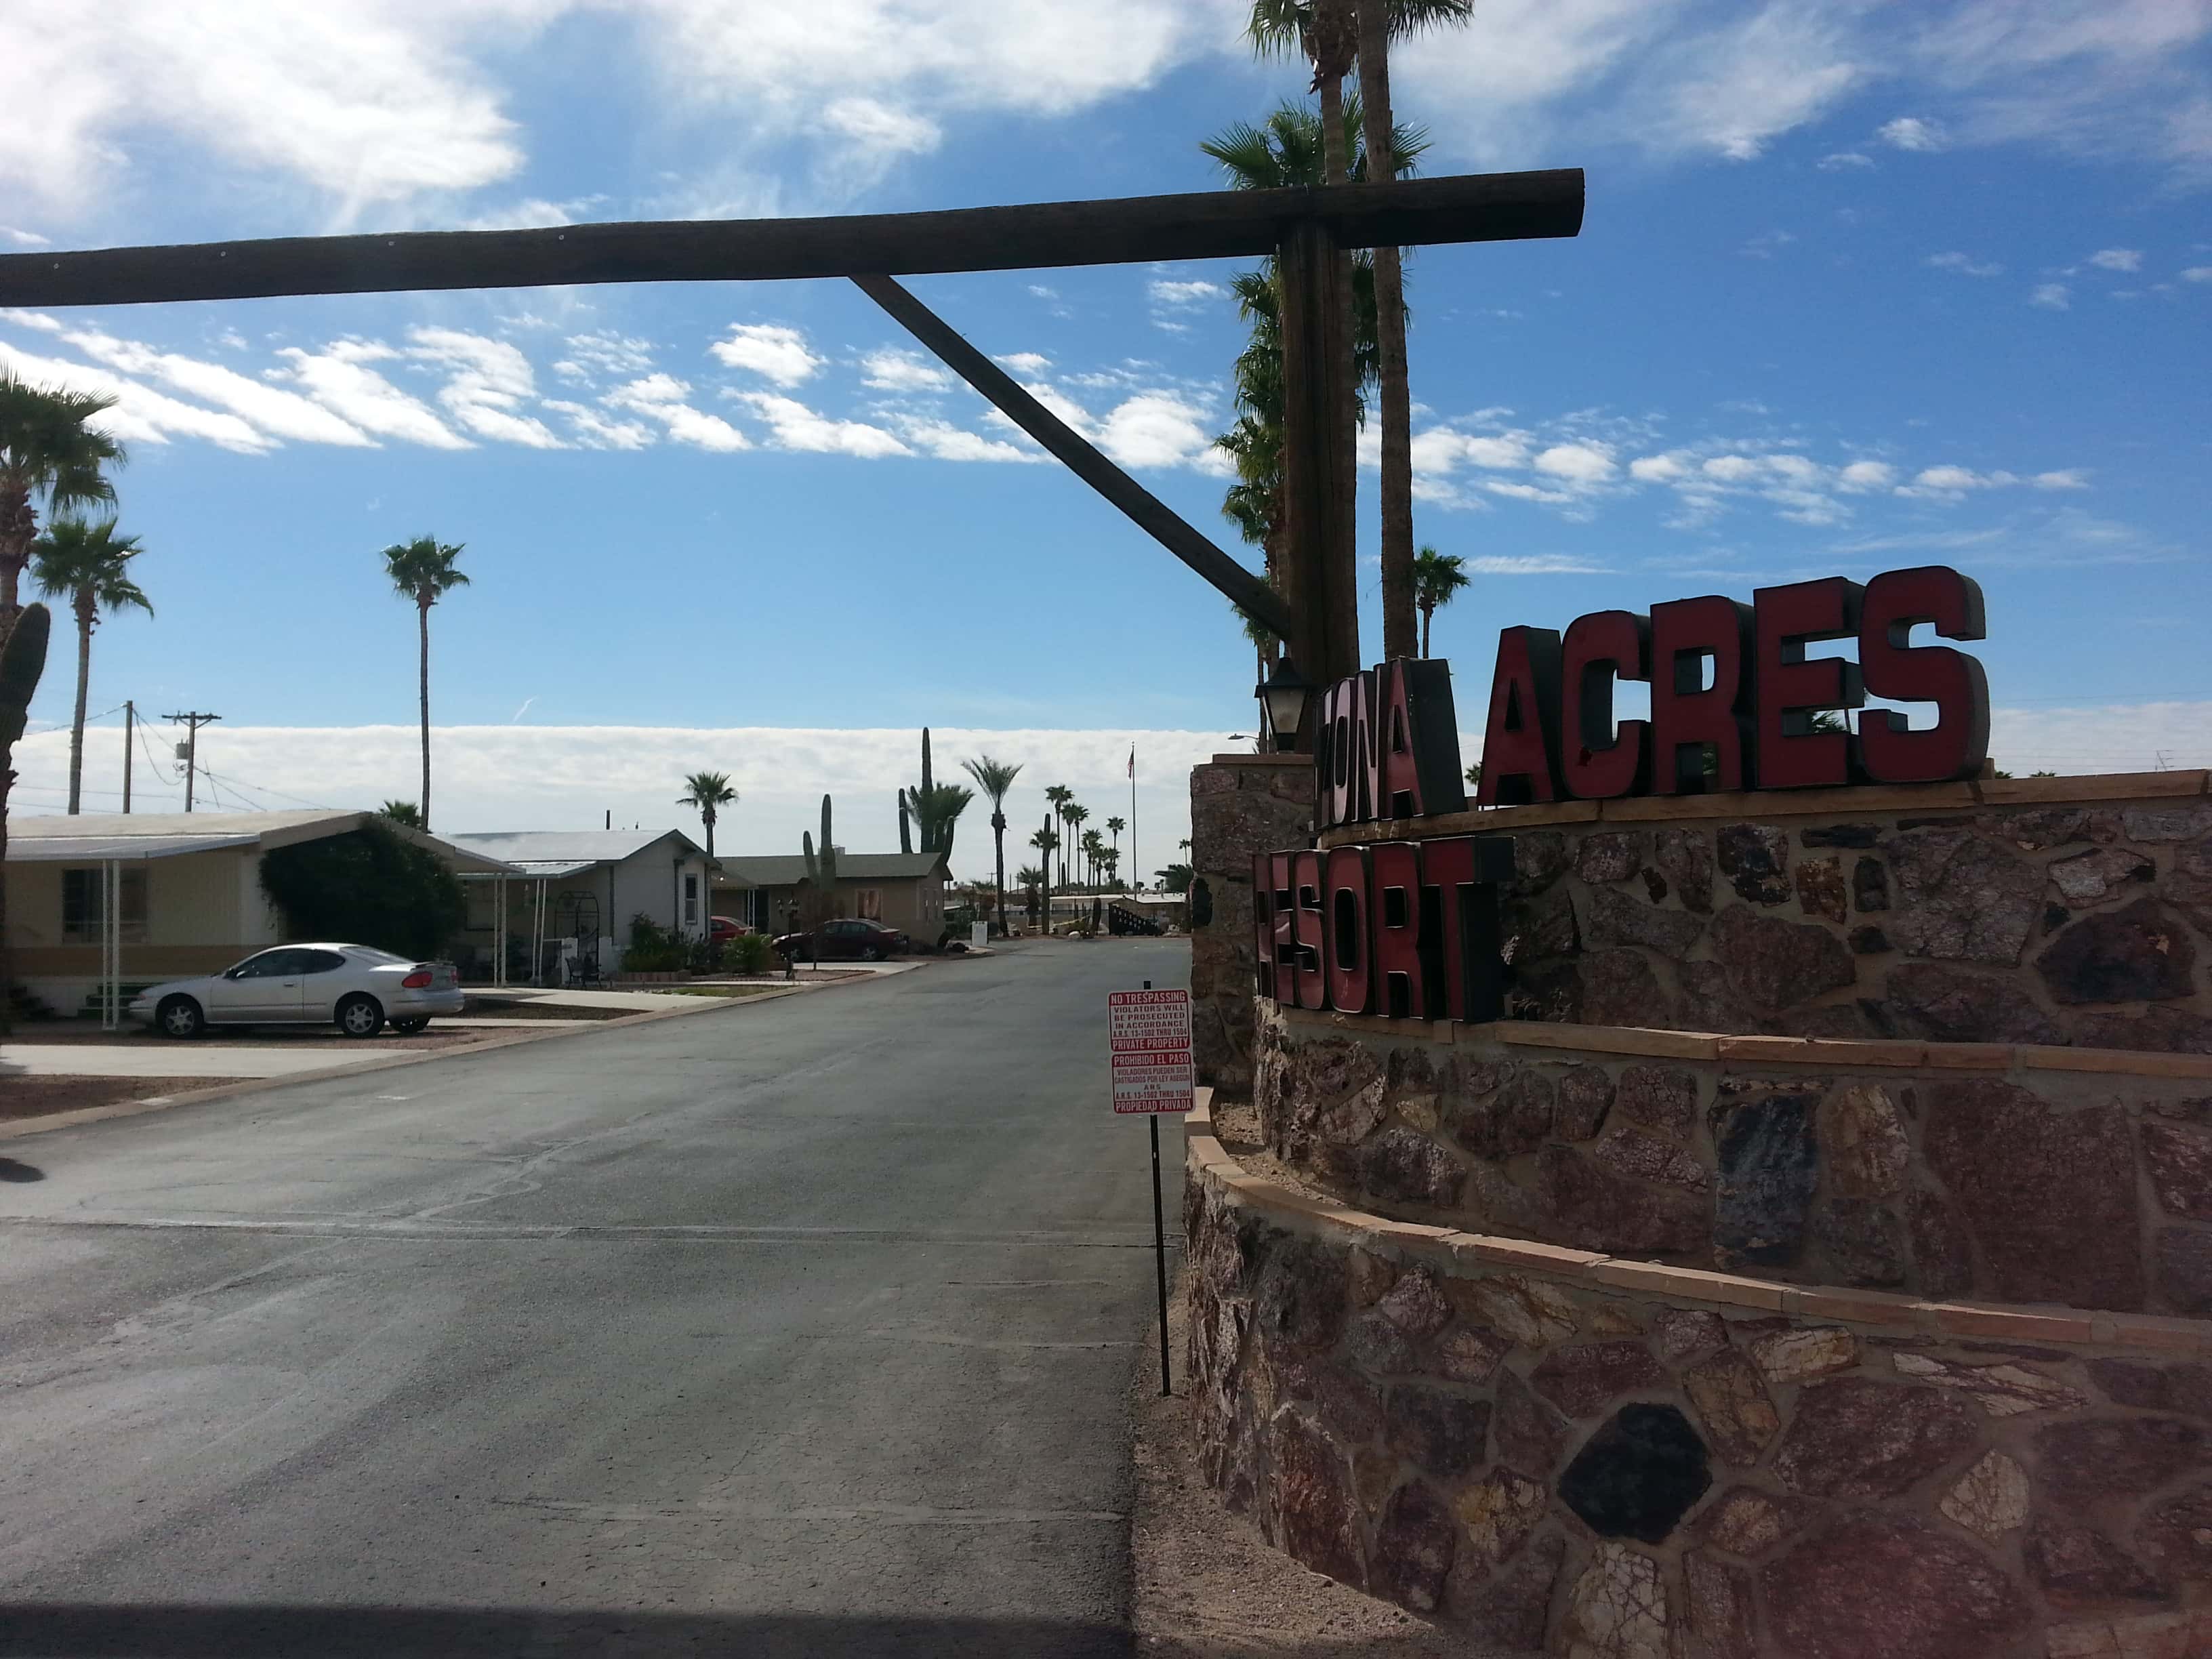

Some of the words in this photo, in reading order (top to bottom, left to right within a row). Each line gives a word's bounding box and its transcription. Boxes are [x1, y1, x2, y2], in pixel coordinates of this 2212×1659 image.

[1480, 566, 1979, 806] ACRES
[1254, 835, 1475, 1021] RESORT
[1111, 994, 1123, 1004] NO
[1126, 991, 1185, 1004] TRESPASSING
[1113, 1005, 1161, 1013] VIOLATORS
[1128, 1012, 1185, 1021] PROSECUTED
[1126, 1020, 1184, 1029] ACCORDANCE
[1132, 1029, 1155, 1037] 13-1502
[1174, 1027, 1187, 1036] 1504
[1112, 1039, 1145, 1050] PRIVATE
[1147, 1037, 1188, 1049] PROPERTY
[1114, 1054, 1155, 1066] PROHIBIDO
[1158, 1054, 1166, 1064] EL
[1169, 1052, 1189, 1063] PASO
[1117, 1067, 1152, 1076] VIOLADORES
[1153, 1067, 1174, 1075] PUEDEN
[1159, 1074, 1169, 1082] LEY
[1134, 1090, 1158, 1099] 13-1502
[1159, 1090, 1174, 1098] THRU
[1176, 1089, 1189, 1097] 1504
[1115, 1101, 1158, 1112] PROPIEDAD
[1160, 1099, 1191, 1110] PRIVADA
